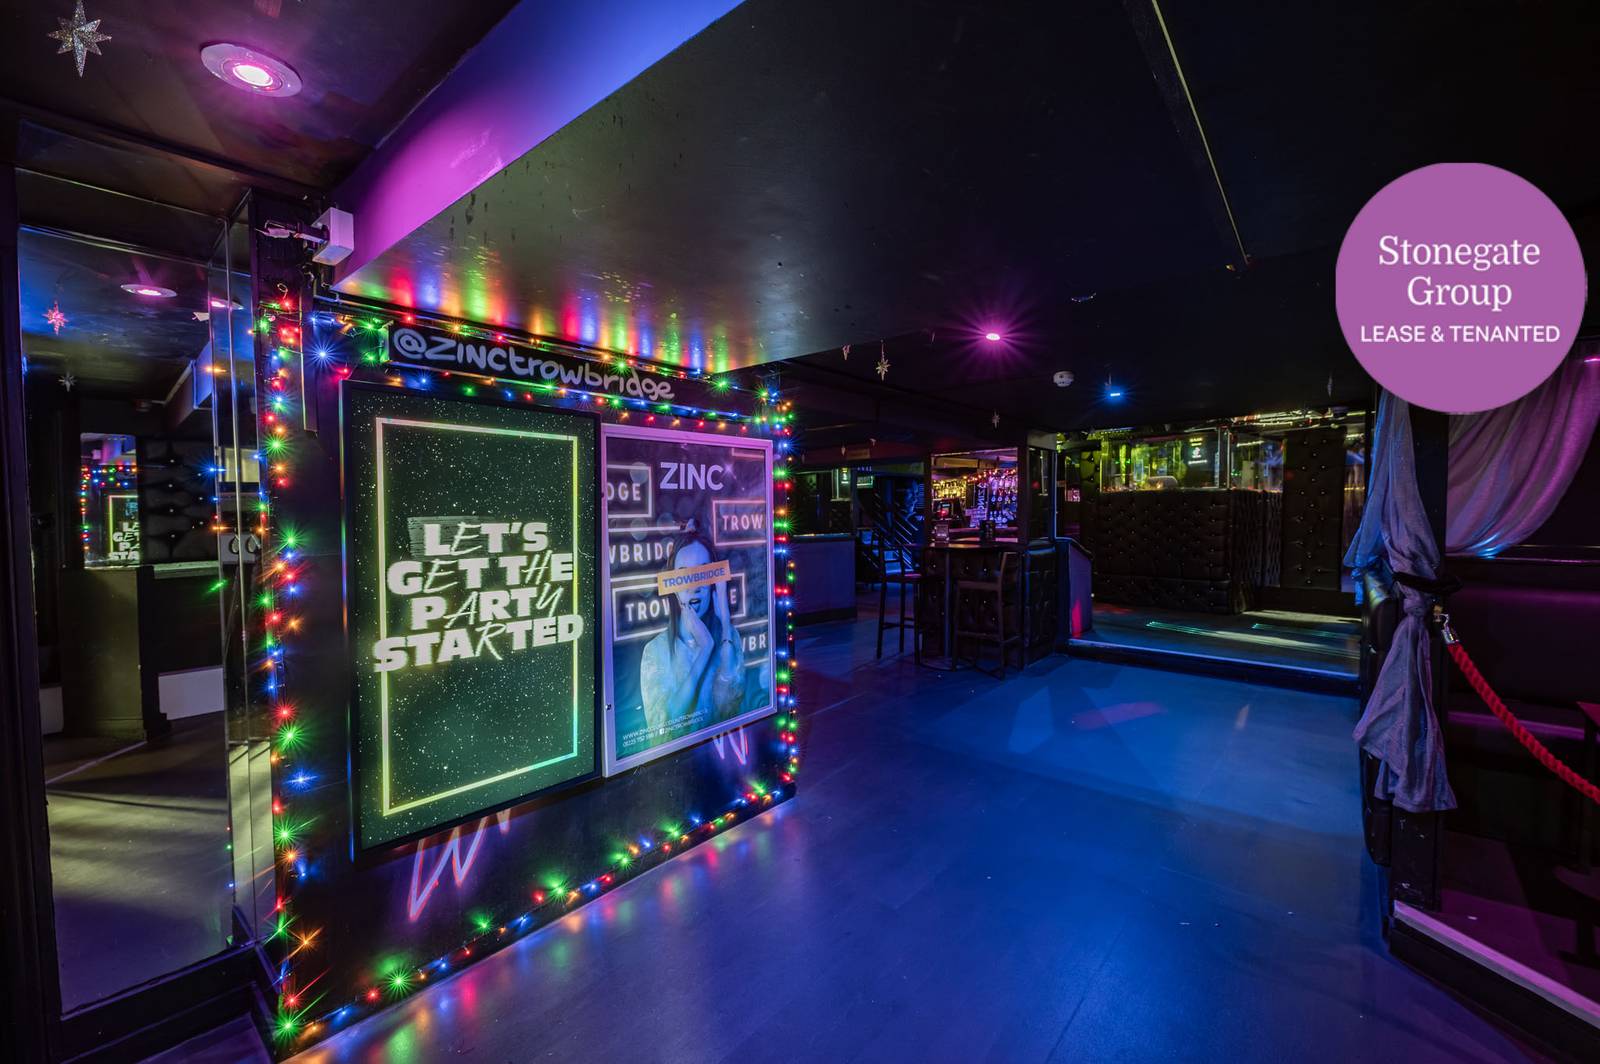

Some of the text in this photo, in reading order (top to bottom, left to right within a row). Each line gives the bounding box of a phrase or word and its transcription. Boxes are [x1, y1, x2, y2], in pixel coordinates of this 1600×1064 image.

[659, 461, 724, 491] ZINC
[423, 521, 548, 556] LET'S
[722, 514, 763, 531] TROW
[386, 550, 574, 595] GET THE
[663, 567, 725, 588] TROWBRIDGE
[410, 582, 564, 630] PARTY
[374, 614, 584, 673] STARTED
[742, 633, 766, 652] BR
